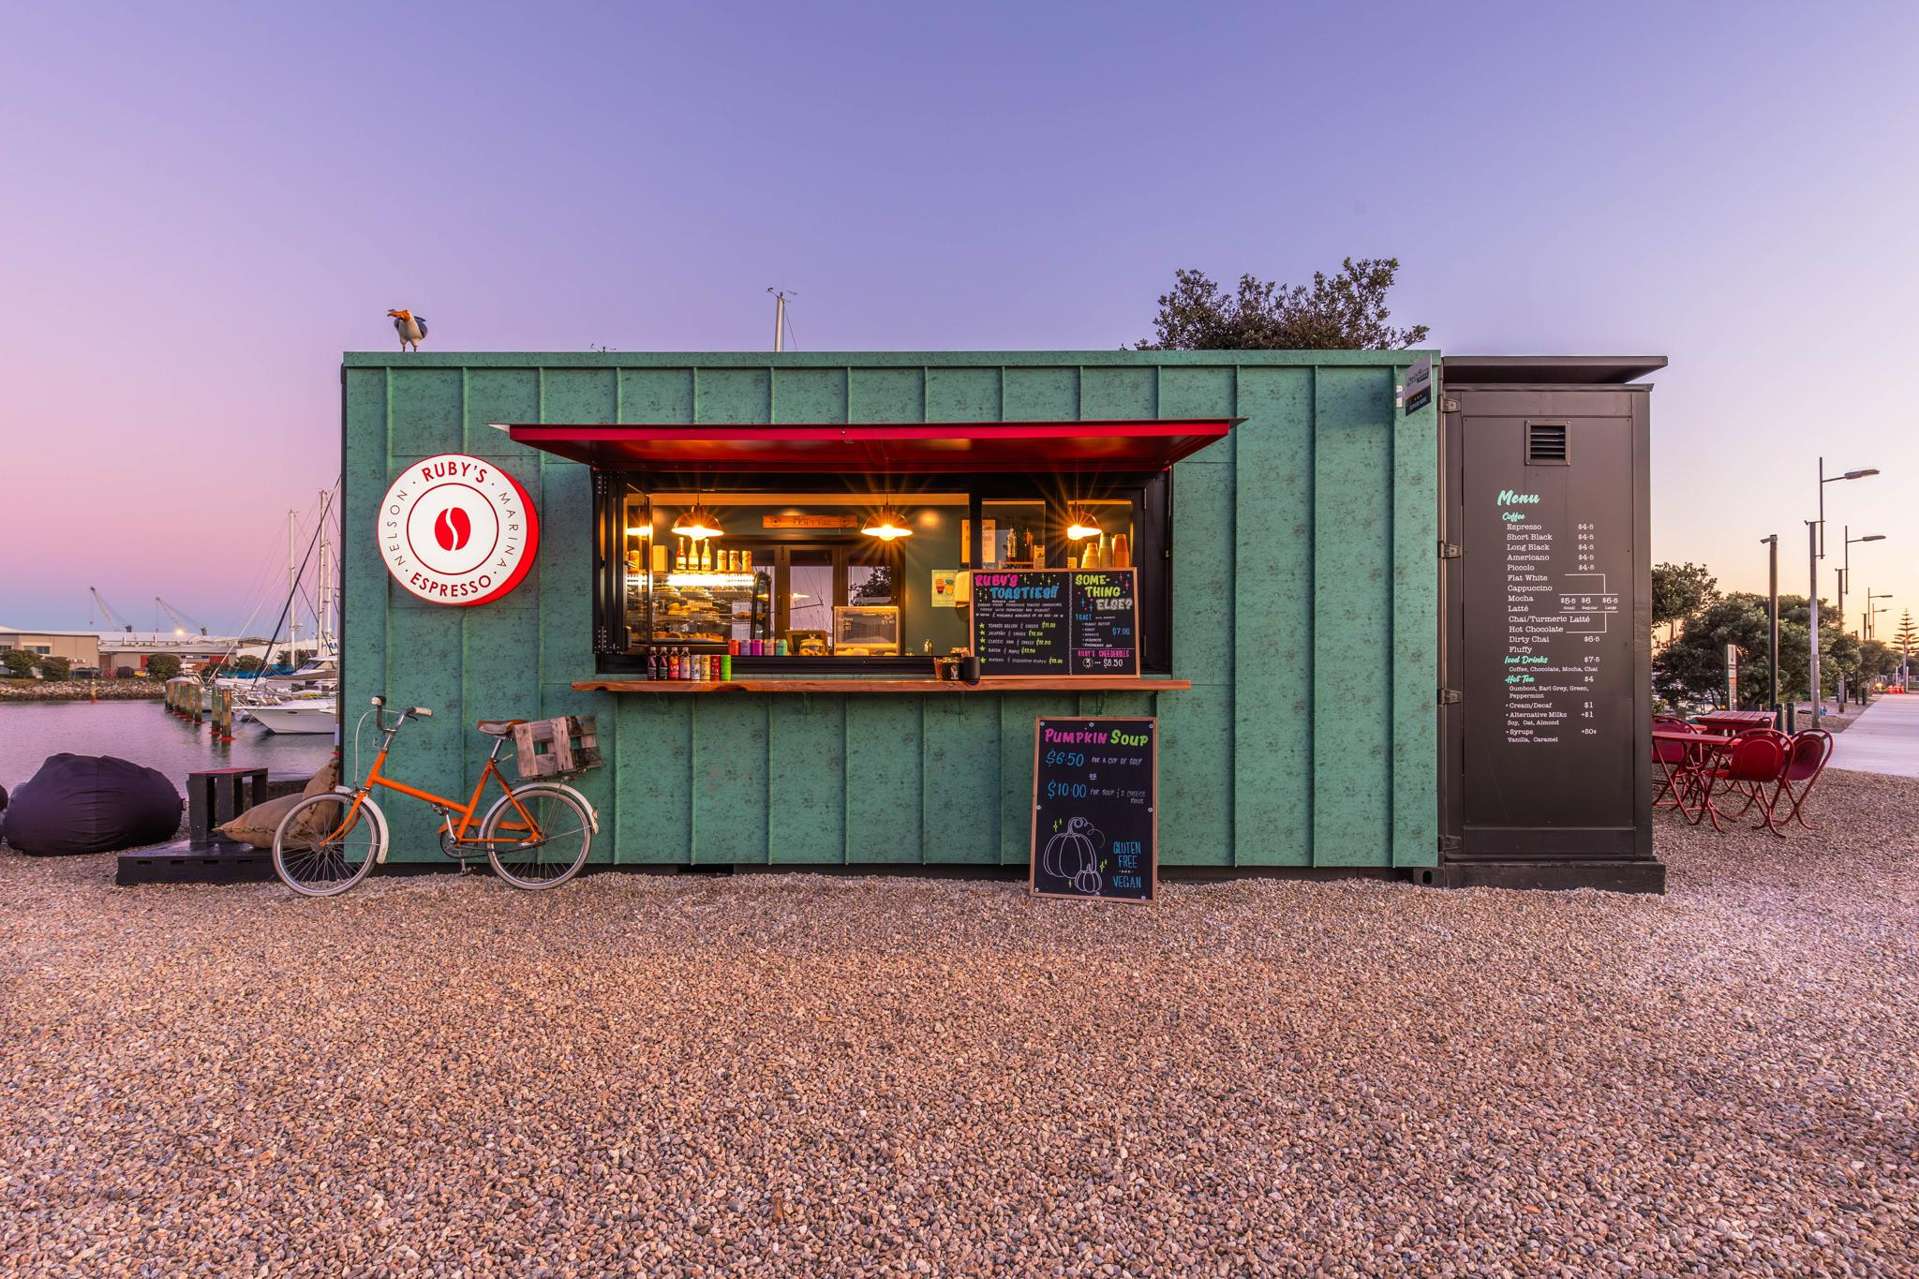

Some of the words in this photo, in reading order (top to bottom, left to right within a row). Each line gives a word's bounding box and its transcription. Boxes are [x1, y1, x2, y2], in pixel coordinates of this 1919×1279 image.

[421, 461, 487, 483] RUBY'S
[1497, 490, 1541, 506] Menu
[1502, 512, 1525, 522] Coffee
[387, 490, 408, 567] NELSON
[496, 491, 519, 569] MARINA
[410, 572, 492, 597] ESPRESSO
[975, 574, 1019, 586] RUBY'S
[1085, 586, 1120, 597] THING
[1096, 598, 1132, 610] ELSE?
[1509, 636, 1530, 644] Dirty
[1509, 646, 1532, 654] Fluffy
[1504, 656, 1520, 664] Iced
[1520, 656, 1548, 664] Drinks
[1505, 675, 1520, 684] Hot
[1522, 675, 1535, 683] Tea
[1044, 728, 1108, 744] PUMPKIN
[1110, 729, 1149, 746] SOUP
[1113, 841, 1141, 855] GLUTEN
[1118, 855, 1138, 868] FREE
[1113, 876, 1141, 888] VEGAN
